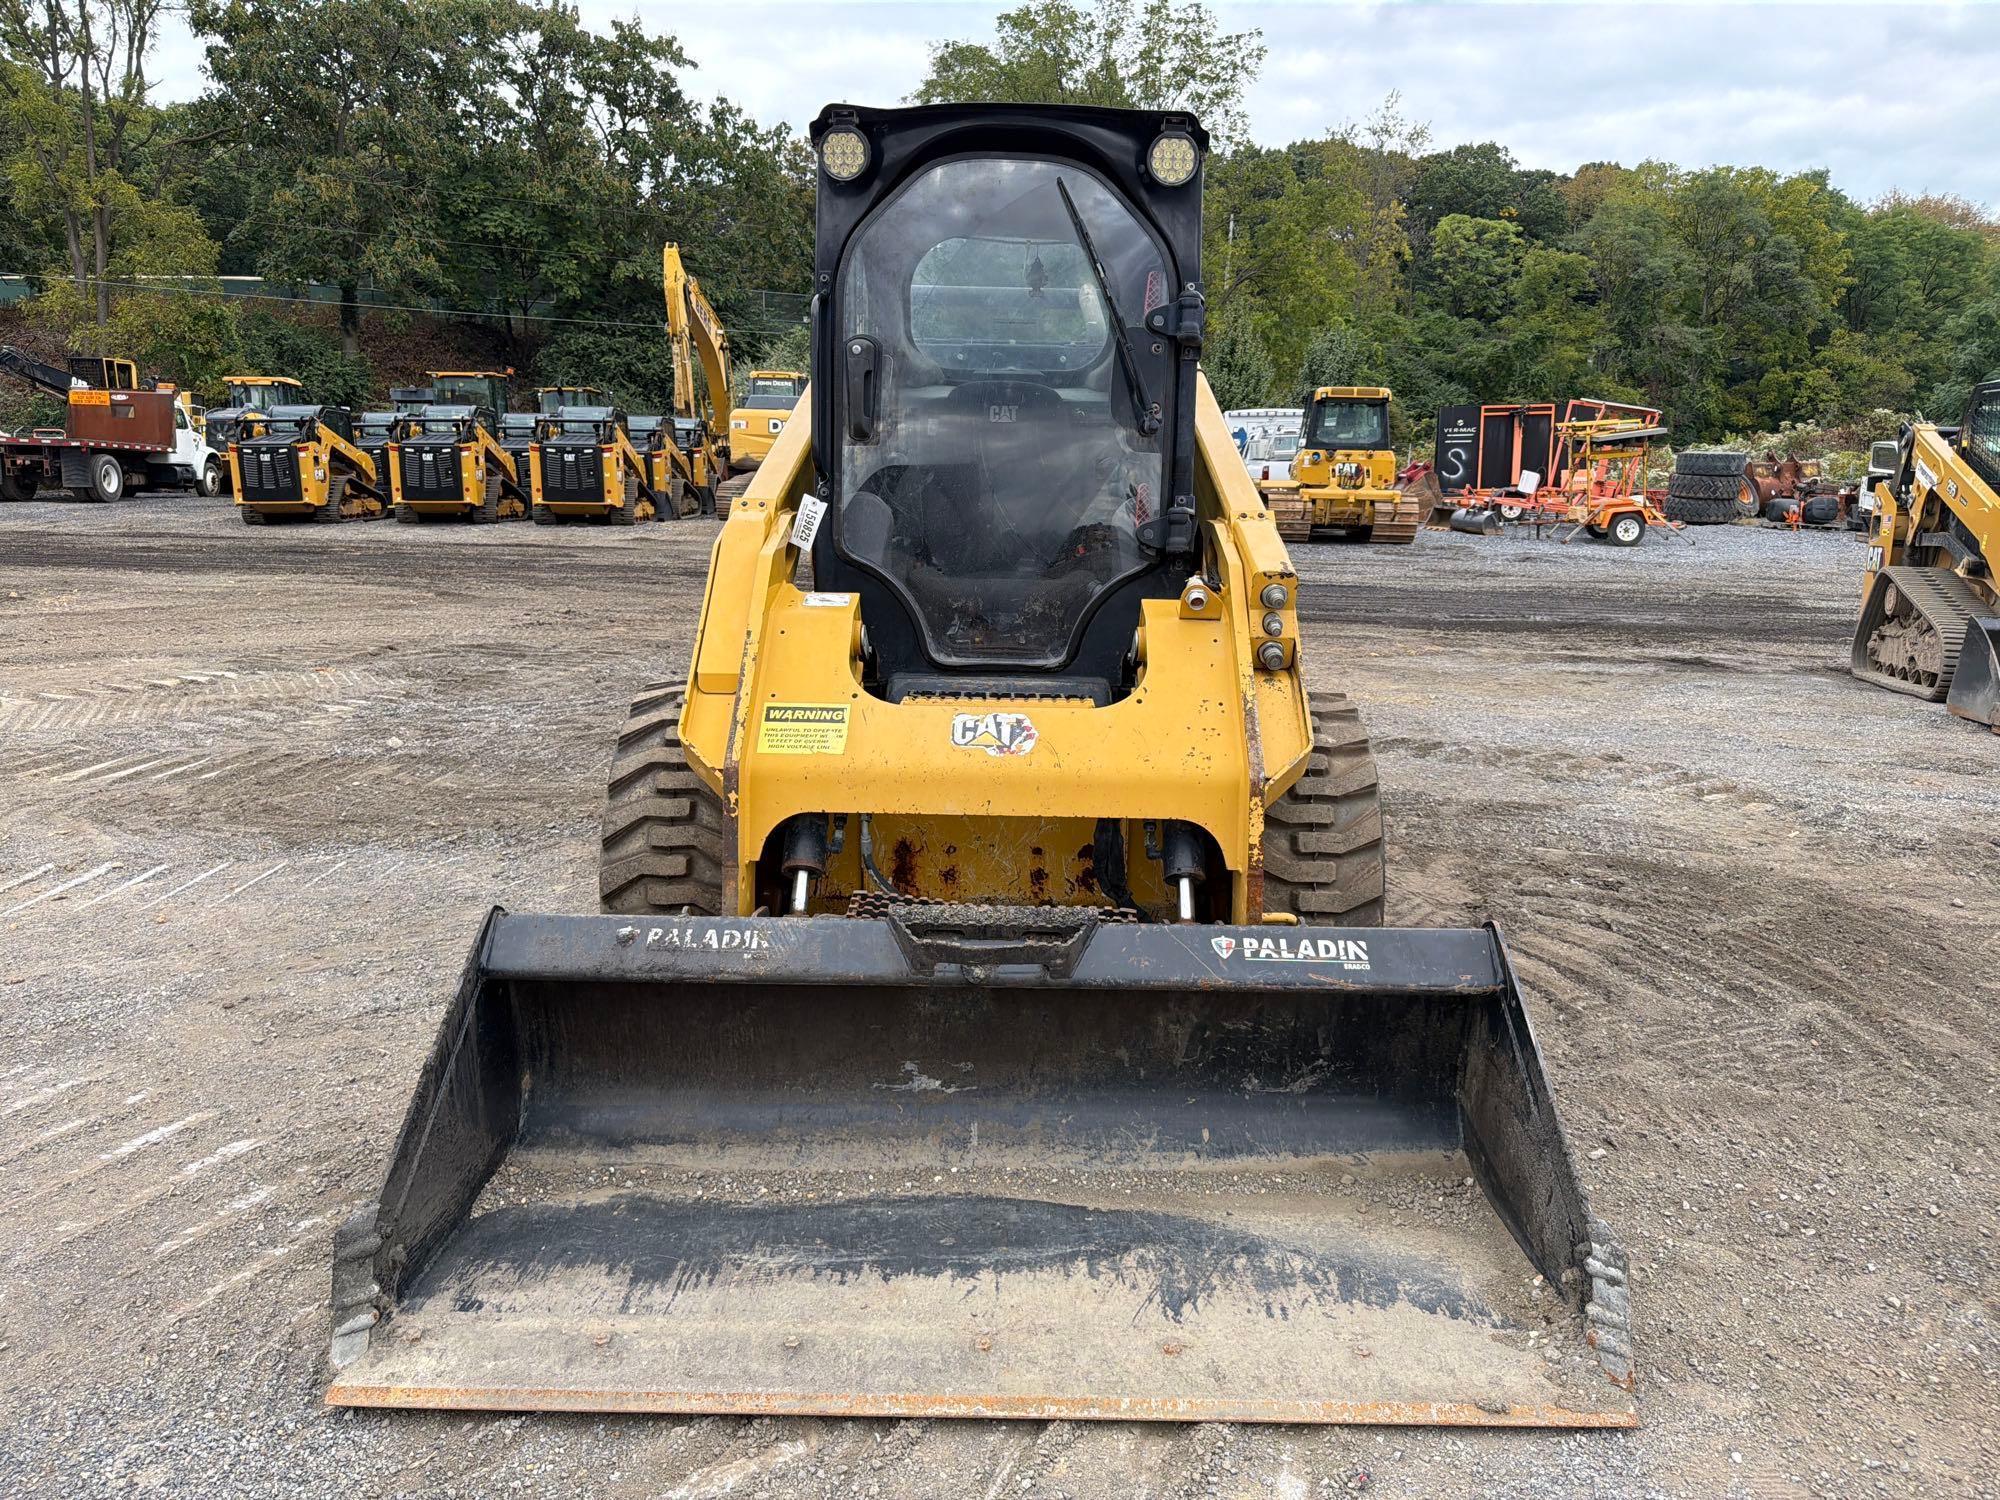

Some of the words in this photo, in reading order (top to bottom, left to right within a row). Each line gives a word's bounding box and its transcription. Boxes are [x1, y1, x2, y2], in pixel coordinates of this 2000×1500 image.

[990, 405, 1019, 422] CAT
[260, 453, 271, 461] CAT
[422, 453, 434, 461] CAT
[564, 453, 576, 461] CAT
[1441, 447, 1466, 478] S
[1335, 462, 1358, 476] CAT
[799, 508, 819, 544] 159825
[1867, 546, 1883, 571] CAT
[769, 709, 844, 721] WARNING
[952, 713, 1017, 746] CAT
[1242, 937, 1369, 961] PALADIN
